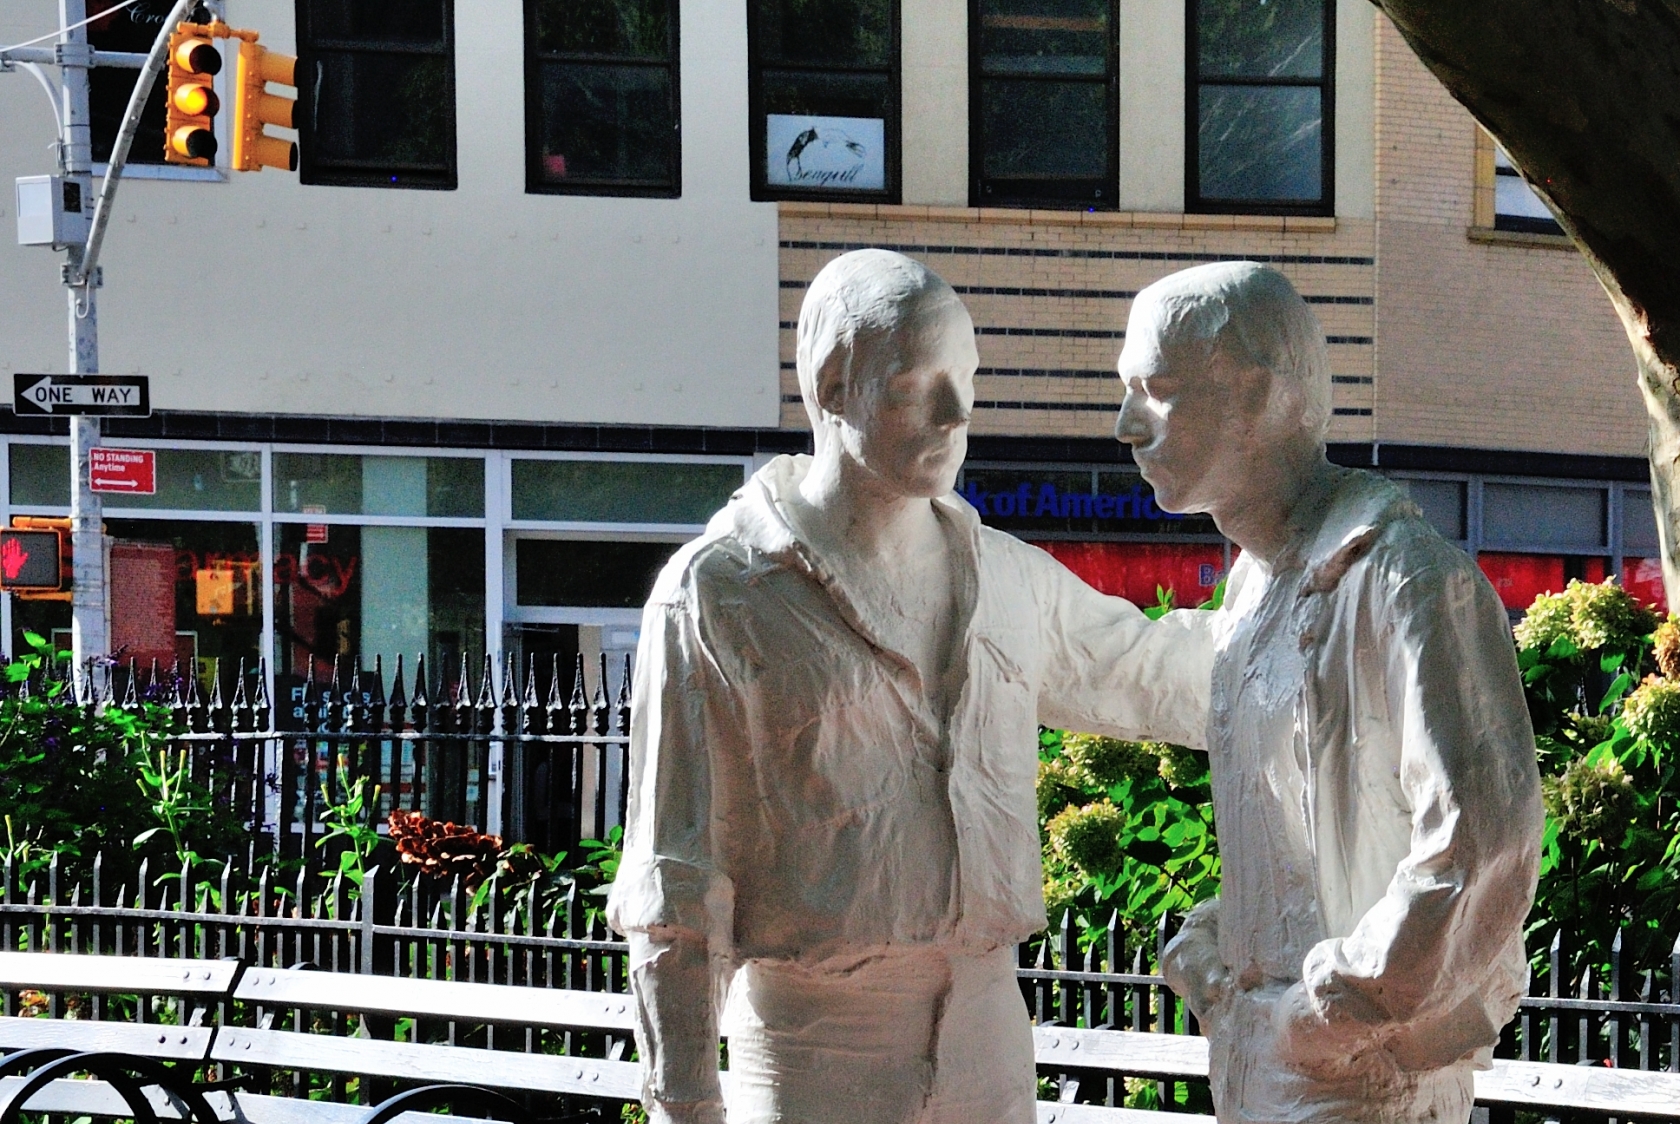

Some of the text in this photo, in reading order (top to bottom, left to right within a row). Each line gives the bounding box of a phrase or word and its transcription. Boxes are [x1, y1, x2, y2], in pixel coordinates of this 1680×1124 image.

[35, 387, 131, 403] ONE WAY
[93, 453, 144, 463] NO STANDING
[93, 463, 125, 472] Anytime
[995, 482, 1032, 516] of
